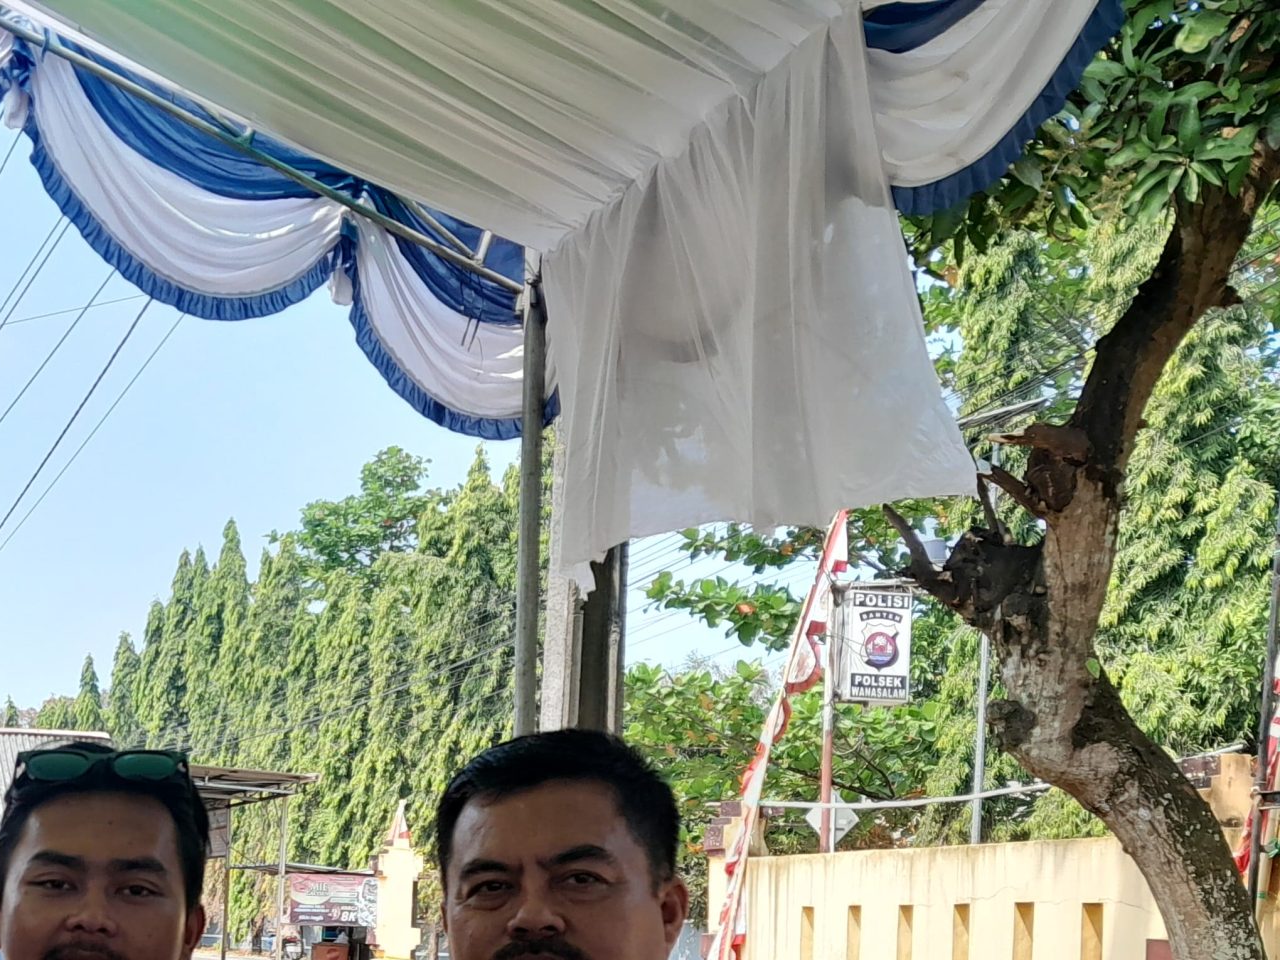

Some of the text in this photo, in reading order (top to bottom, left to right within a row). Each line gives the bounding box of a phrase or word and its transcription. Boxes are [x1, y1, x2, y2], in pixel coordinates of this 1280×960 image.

[855, 593, 909, 608] POLISI
[854, 676, 902, 687] POLSEK
[851, 686, 906, 698] WANASALAM
